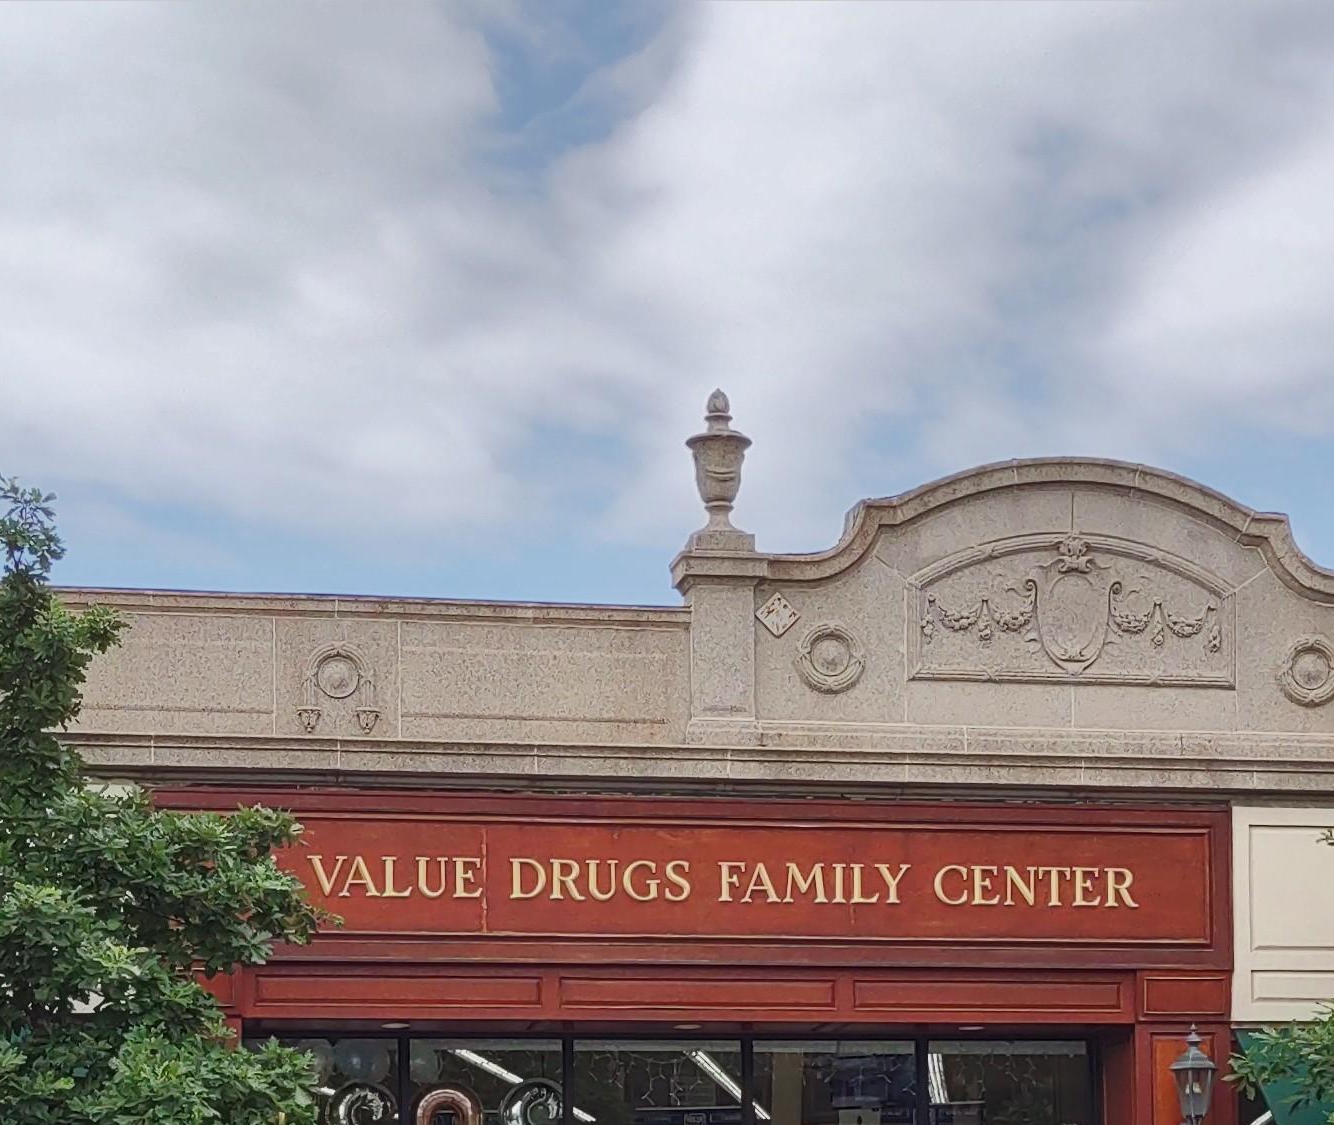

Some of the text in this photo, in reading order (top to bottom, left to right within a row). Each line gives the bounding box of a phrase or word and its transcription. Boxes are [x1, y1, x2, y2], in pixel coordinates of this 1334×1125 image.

[306, 855, 1140, 909] VALUE DRUGS FAMILY CENTER
